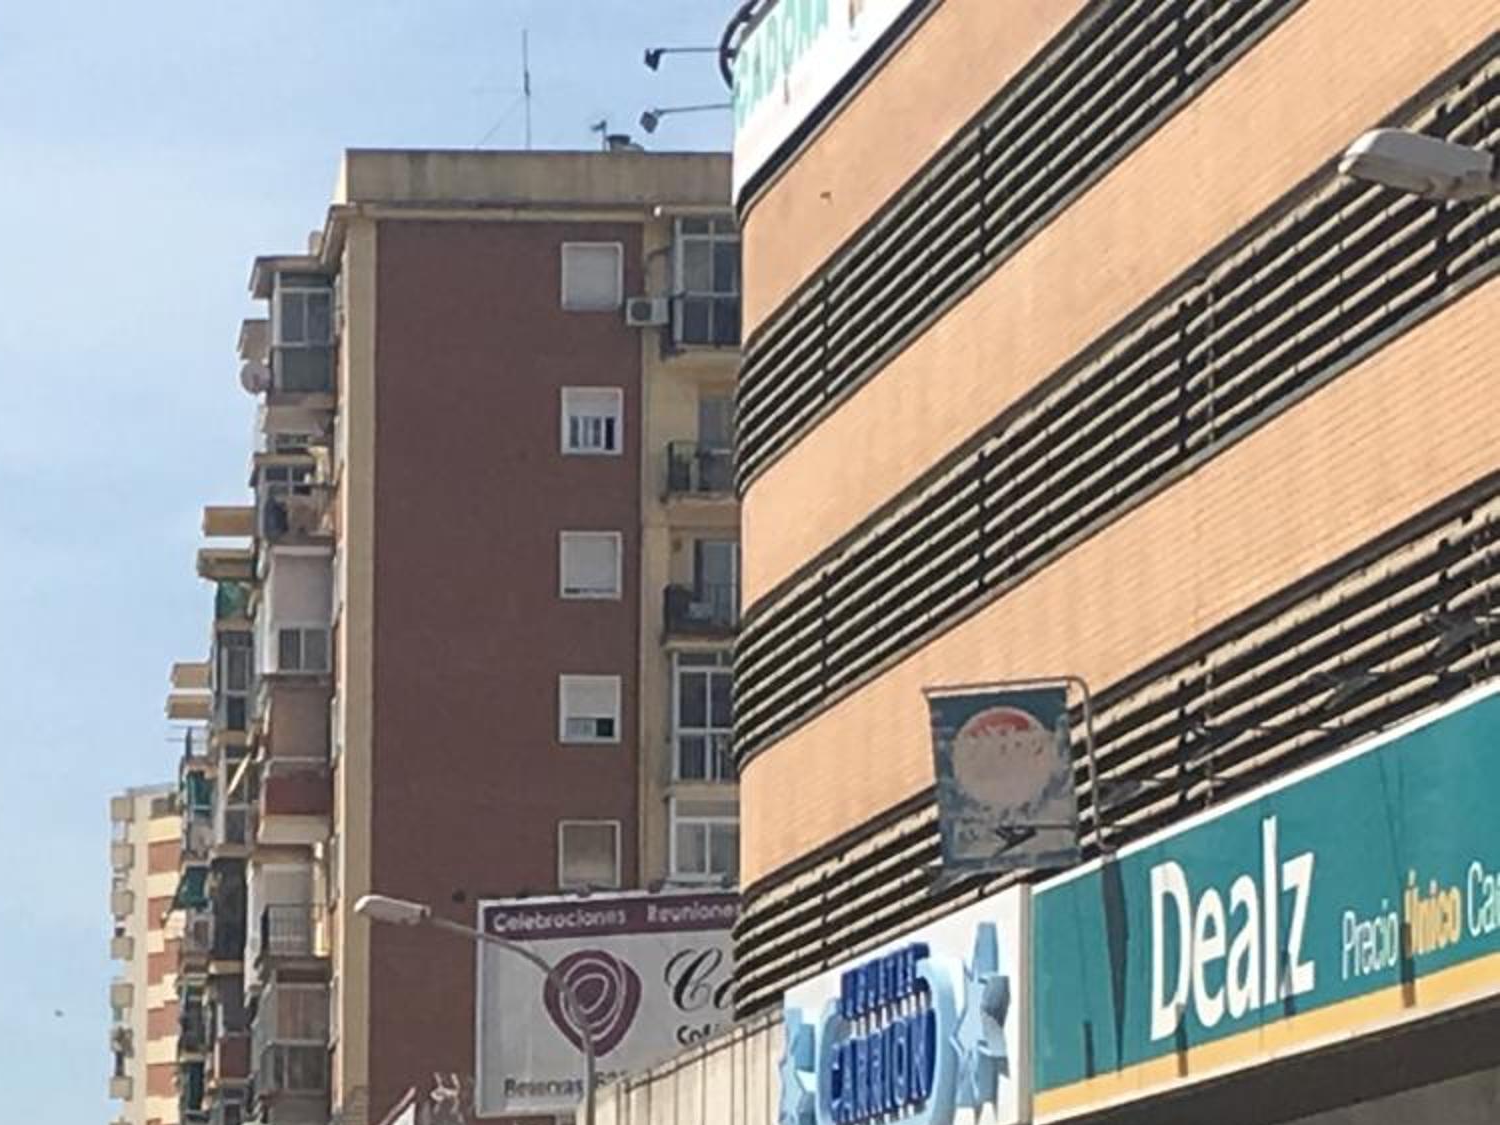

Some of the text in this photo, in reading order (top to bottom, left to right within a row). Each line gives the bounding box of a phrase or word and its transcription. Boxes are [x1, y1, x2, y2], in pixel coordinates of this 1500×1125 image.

[493, 907, 626, 932] Celebraciones
[1151, 815, 1315, 1041] Dealz
[1342, 898, 1399, 981] Precio
